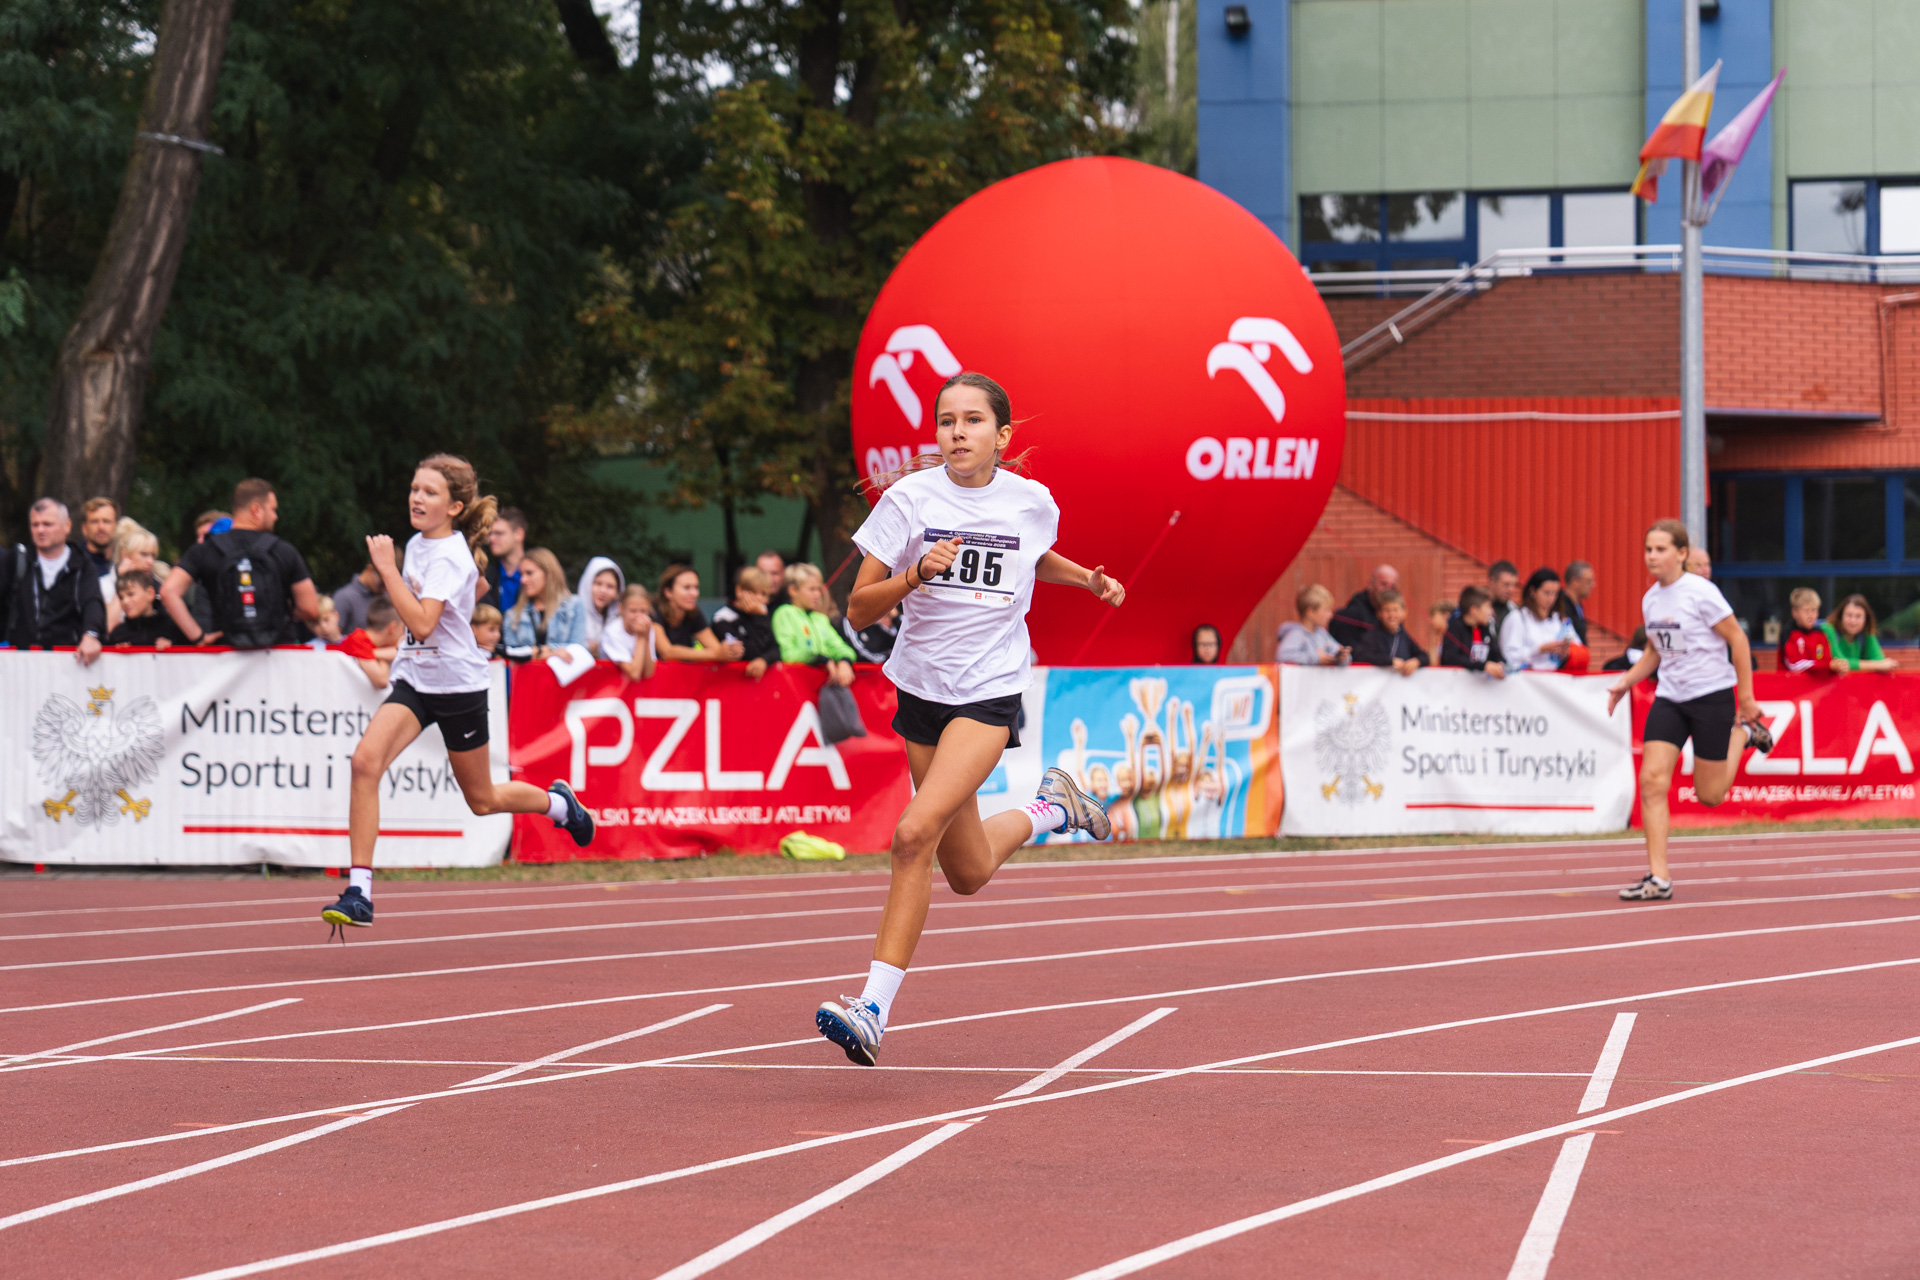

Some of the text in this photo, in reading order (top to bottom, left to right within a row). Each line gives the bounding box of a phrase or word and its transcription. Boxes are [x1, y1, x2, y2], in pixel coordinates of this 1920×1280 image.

[1185, 436, 1319, 480] ORLEN
[181, 699, 371, 737] Ministerst
[1401, 704, 1549, 737] Ministerstwo
[1681, 699, 1915, 776] ZLA
[565, 697, 852, 792] PZLA
[1402, 745, 1597, 783] Sportu i Turystyki
[180, 752, 310, 795] Sportu
[327, 755, 333, 789] i
[774, 805, 851, 824] ATLETYKI
